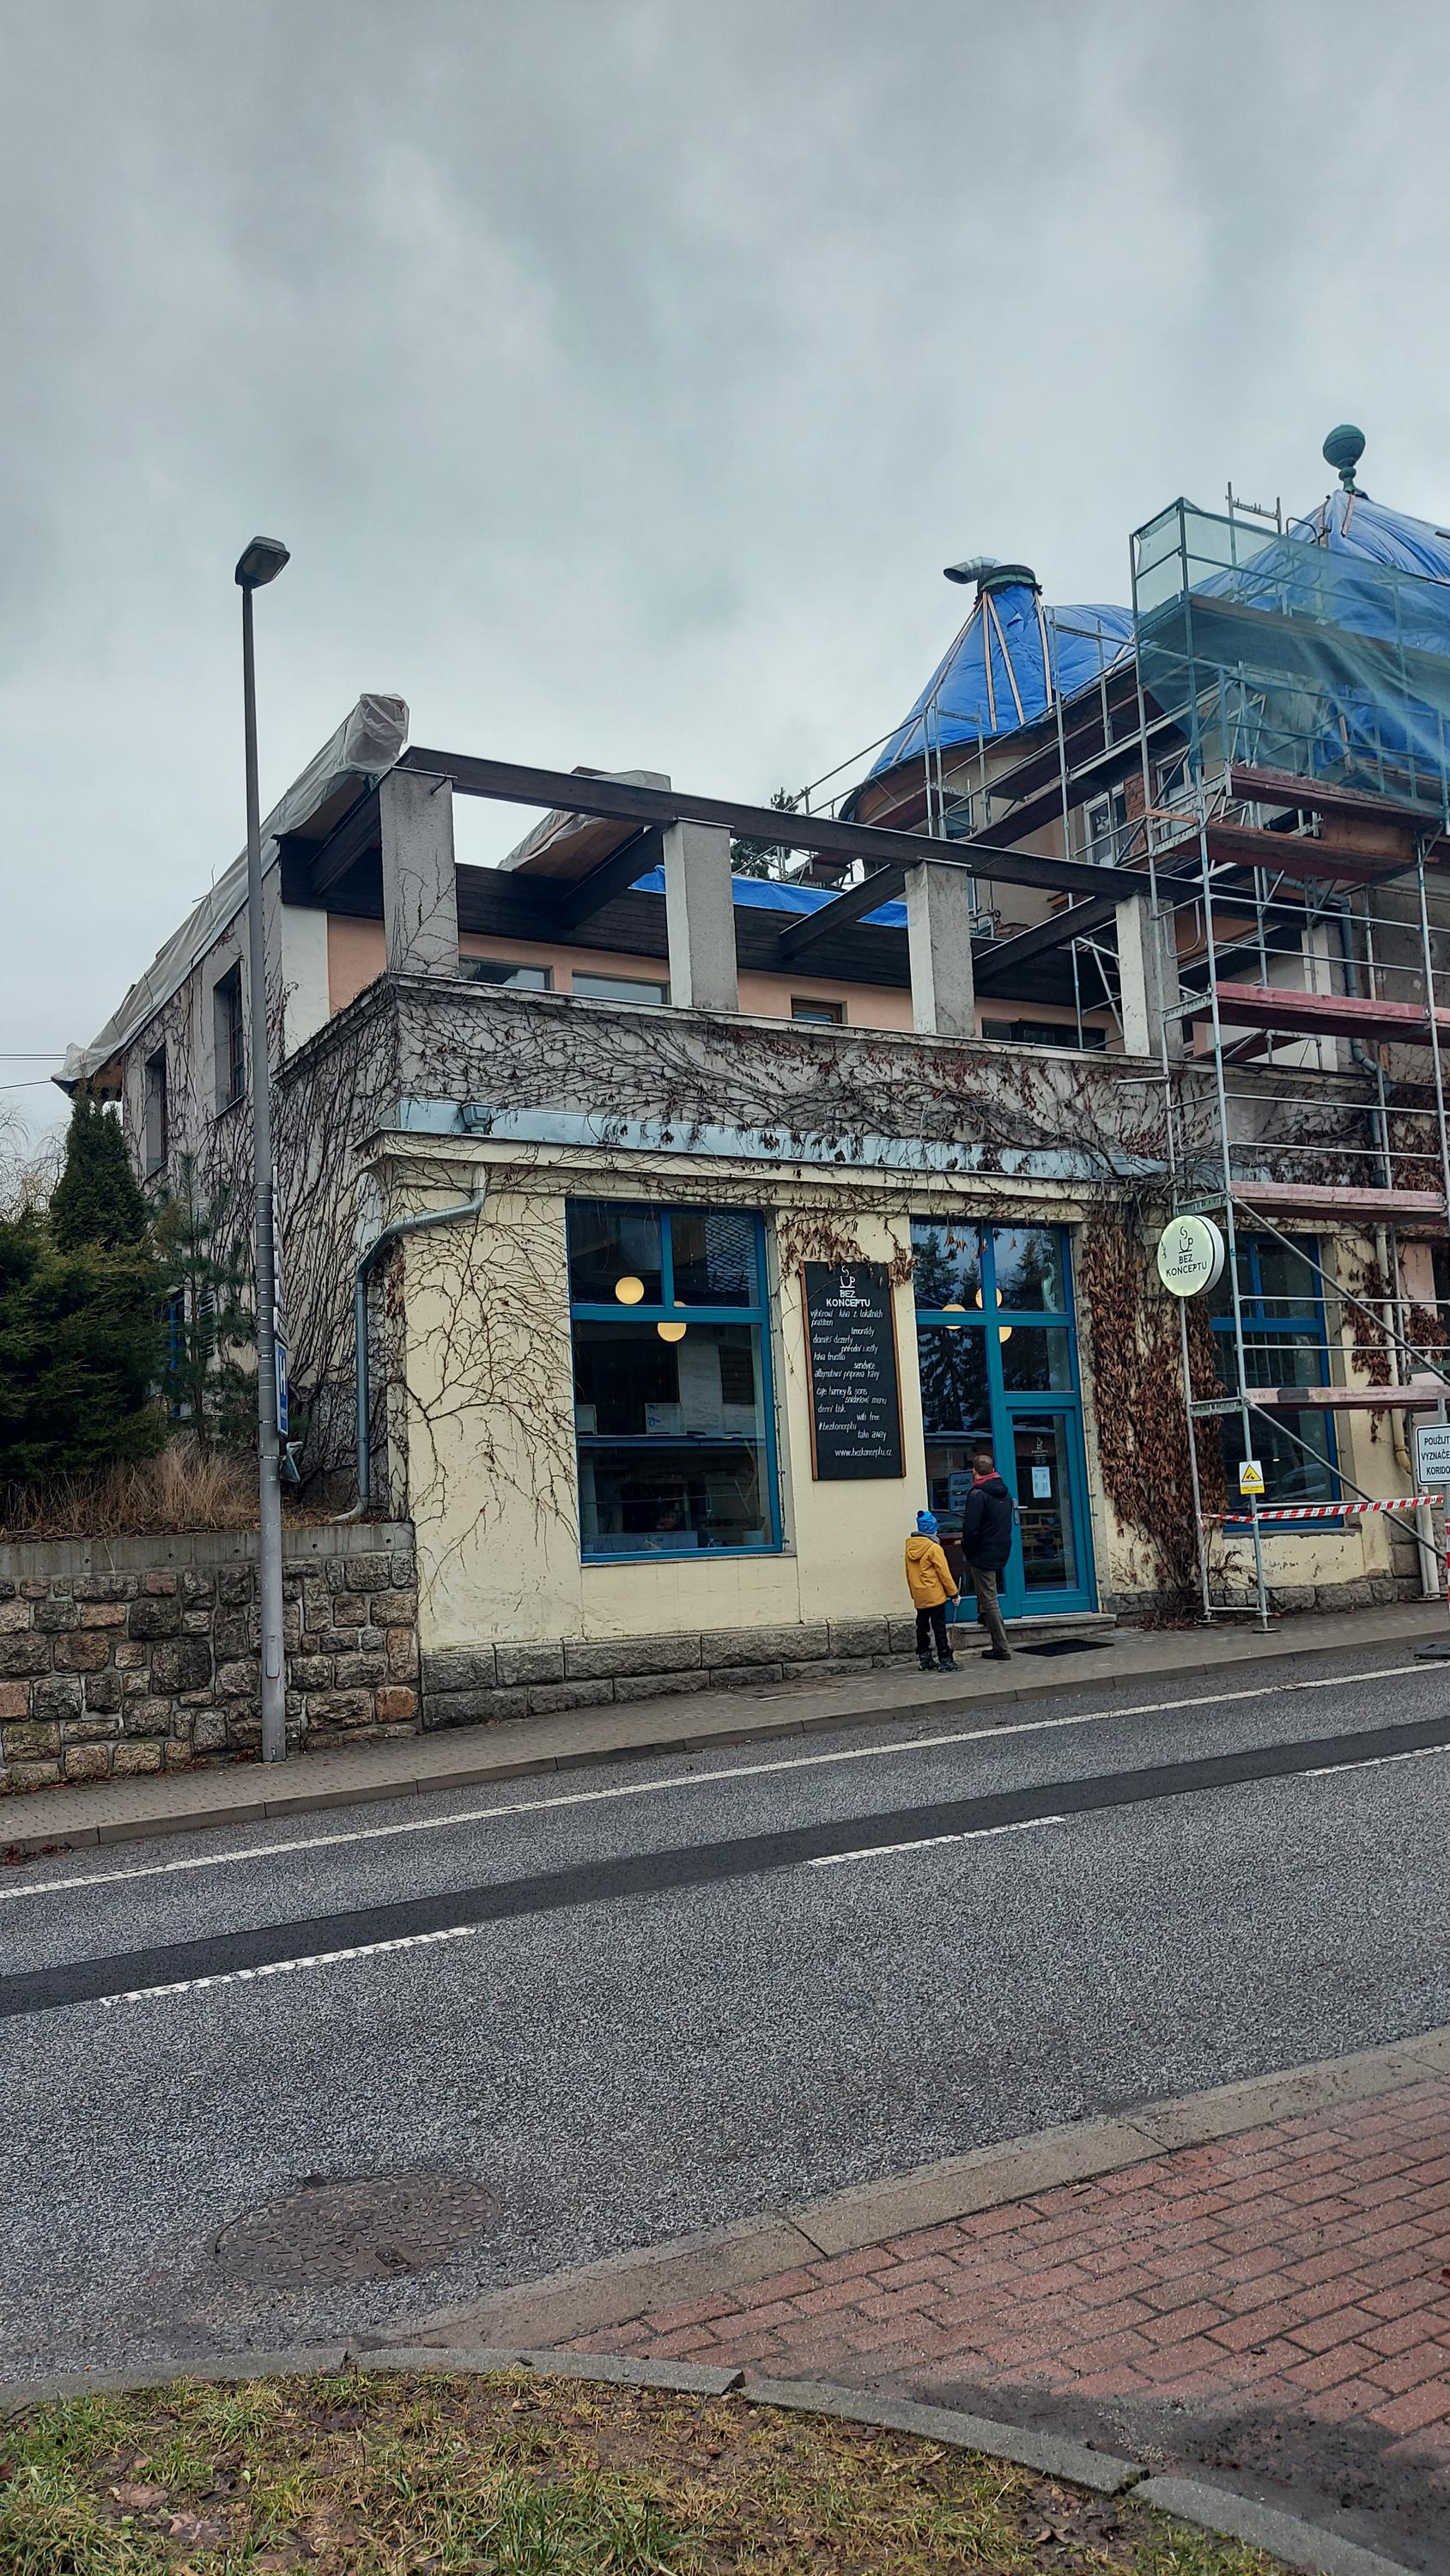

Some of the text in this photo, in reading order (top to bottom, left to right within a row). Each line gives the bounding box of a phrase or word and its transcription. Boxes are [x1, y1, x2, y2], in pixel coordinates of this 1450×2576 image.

[1179, 1254, 1193, 1264] BEZ
[1166, 1261, 1207, 1277] KONCEPTU
[826, 1298, 871, 1307] KONCEPTU
[851, 1326, 875, 1337] limonády
[846, 1386, 852, 1395] &
[856, 1411, 881, 1421] wifi free
[818, 1420, 857, 1433] #bezkonceptu
[858, 1430, 887, 1442] take away
[834, 1445, 893, 1459] www.bezkonceptu.cz
